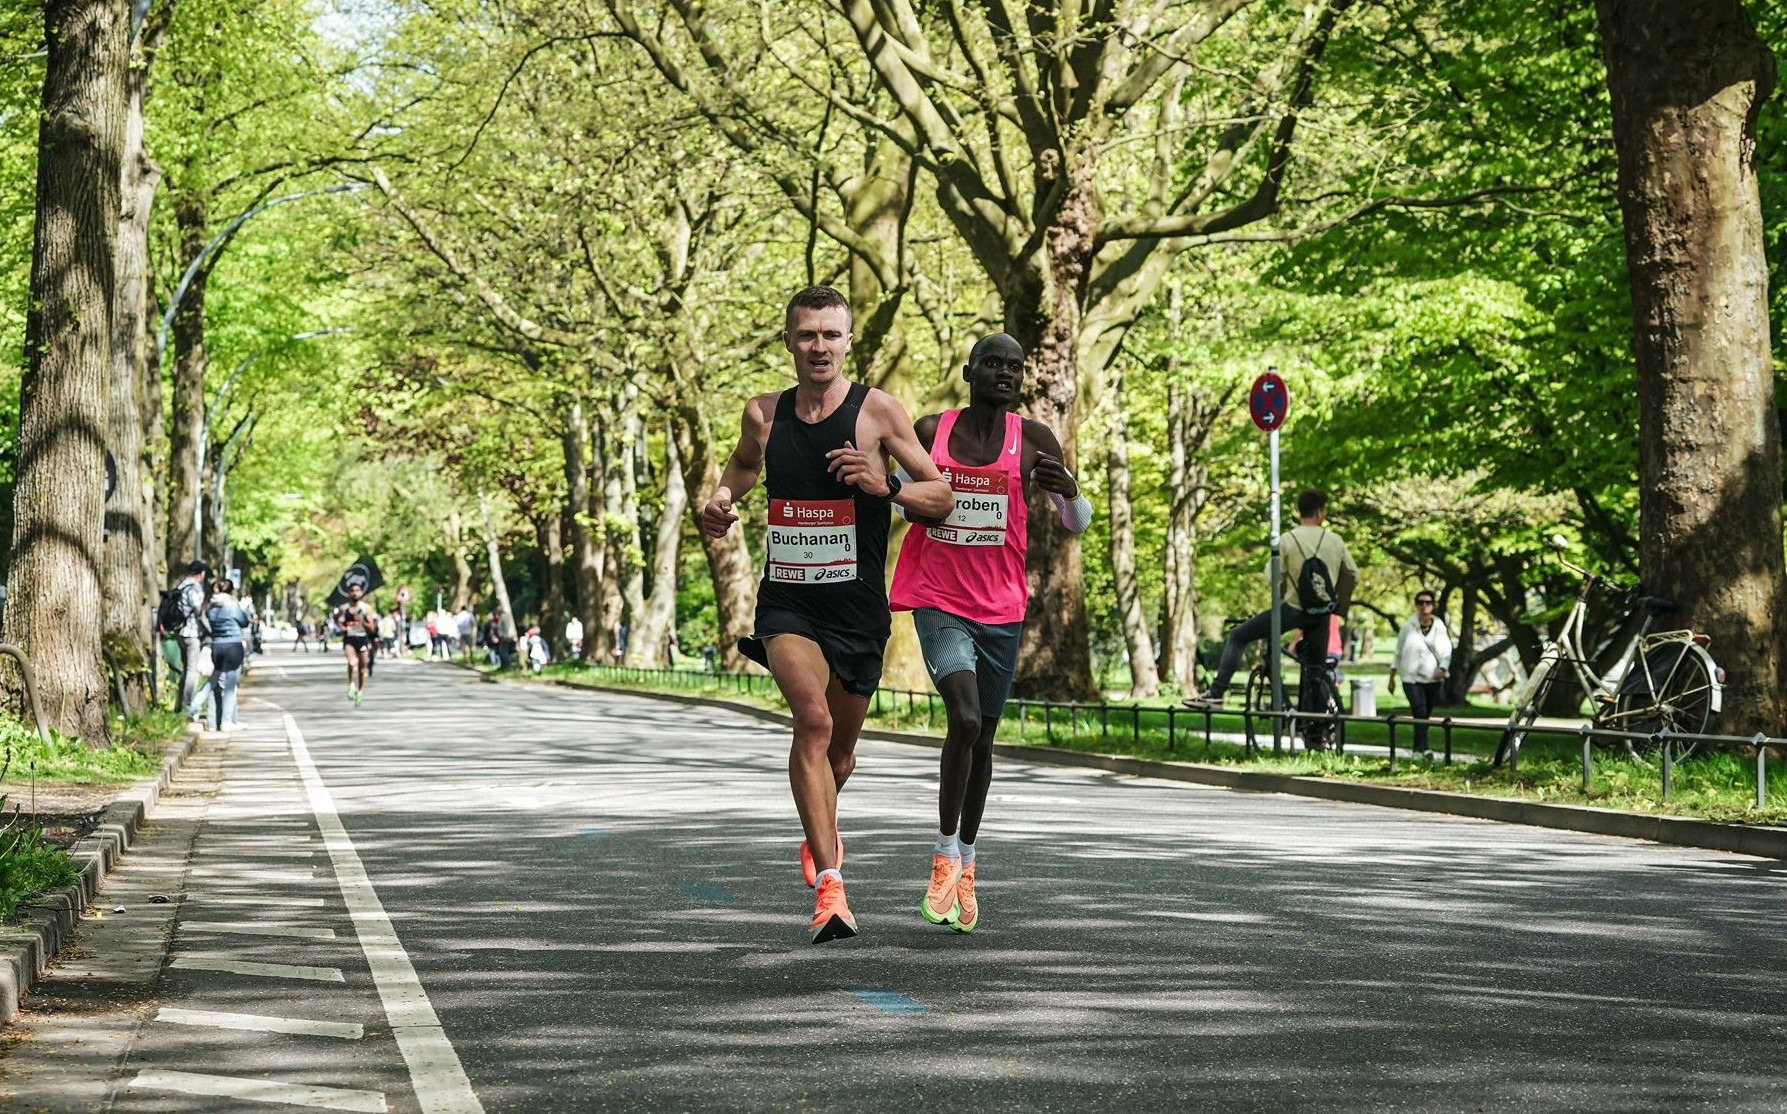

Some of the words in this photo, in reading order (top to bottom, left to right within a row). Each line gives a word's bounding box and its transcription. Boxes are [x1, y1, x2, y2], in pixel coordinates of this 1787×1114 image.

[955, 473, 990, 487] Haspa
[955, 498, 1000, 511] roben
[797, 507, 834, 520] Haspa
[771, 531, 849, 546] Buchanan
[931, 528, 956, 541] REWE
[844, 543, 851, 552] 0
[803, 551, 813, 559] 30
[776, 568, 804, 580] REWE
